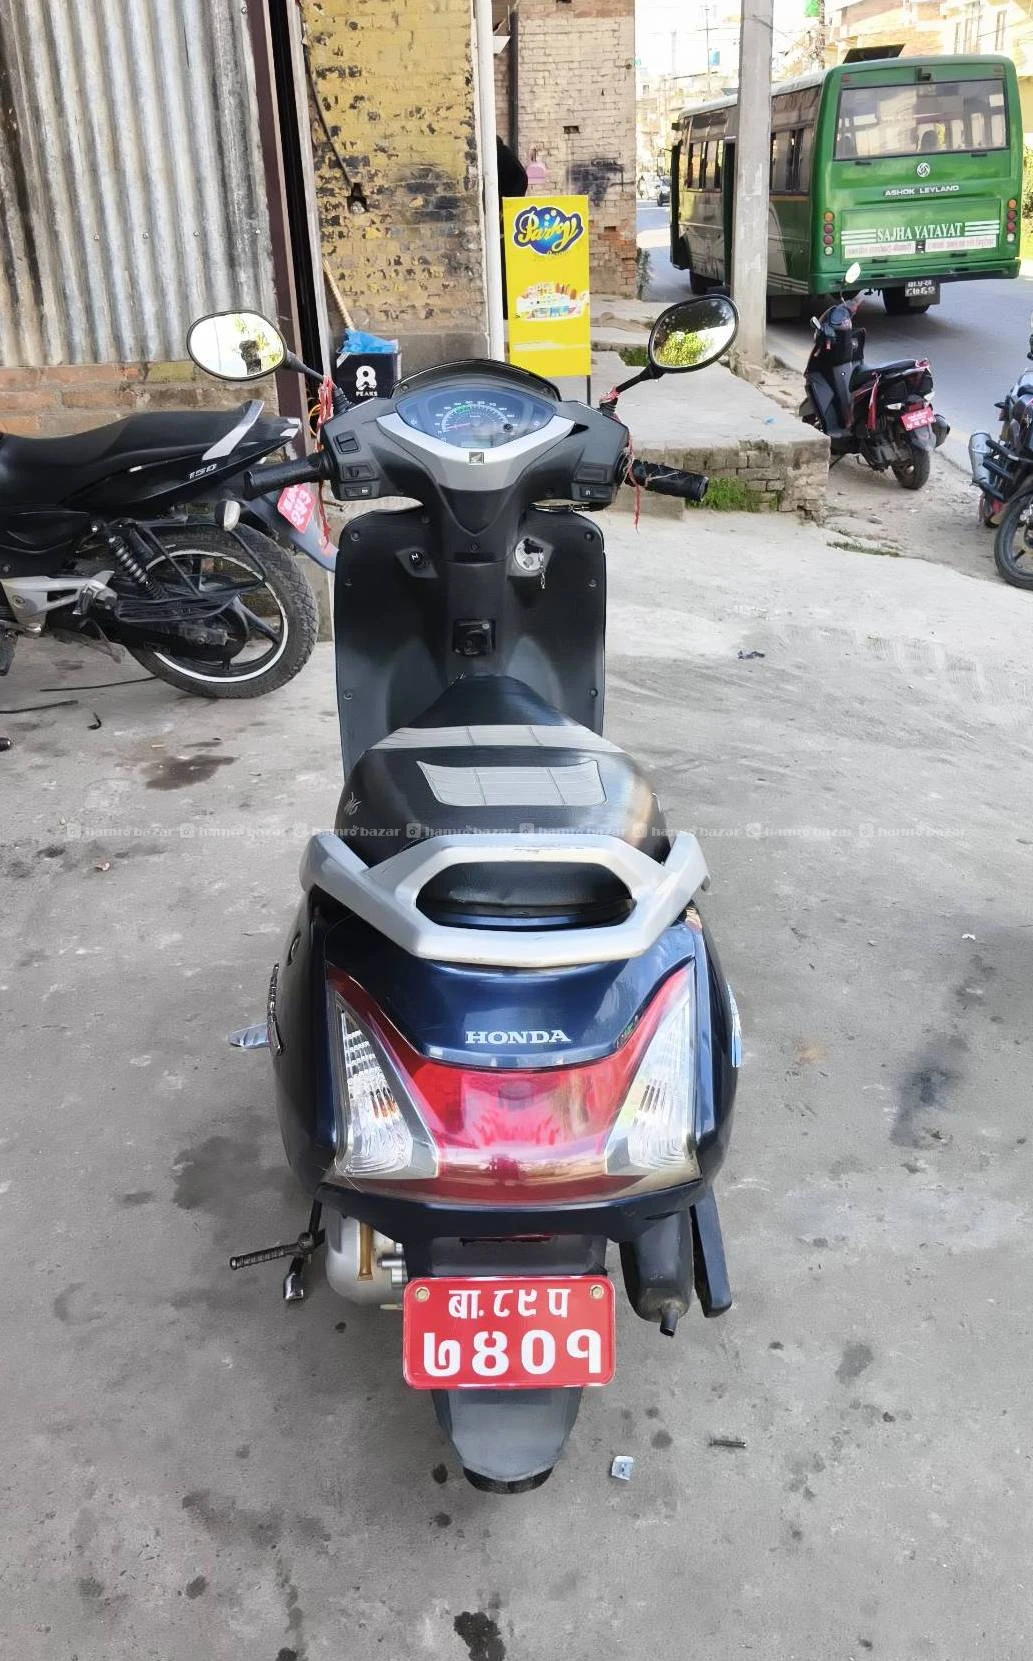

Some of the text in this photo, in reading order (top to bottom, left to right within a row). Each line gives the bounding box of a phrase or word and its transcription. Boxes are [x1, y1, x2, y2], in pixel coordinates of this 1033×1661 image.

[884, 184, 960, 197] ASHOK LEYLAND
[877, 222, 963, 242] SAJHA YATAYAT
[465, 1029, 572, 1045] HONDA
[423, 1328, 602, 1377] ७४०१
